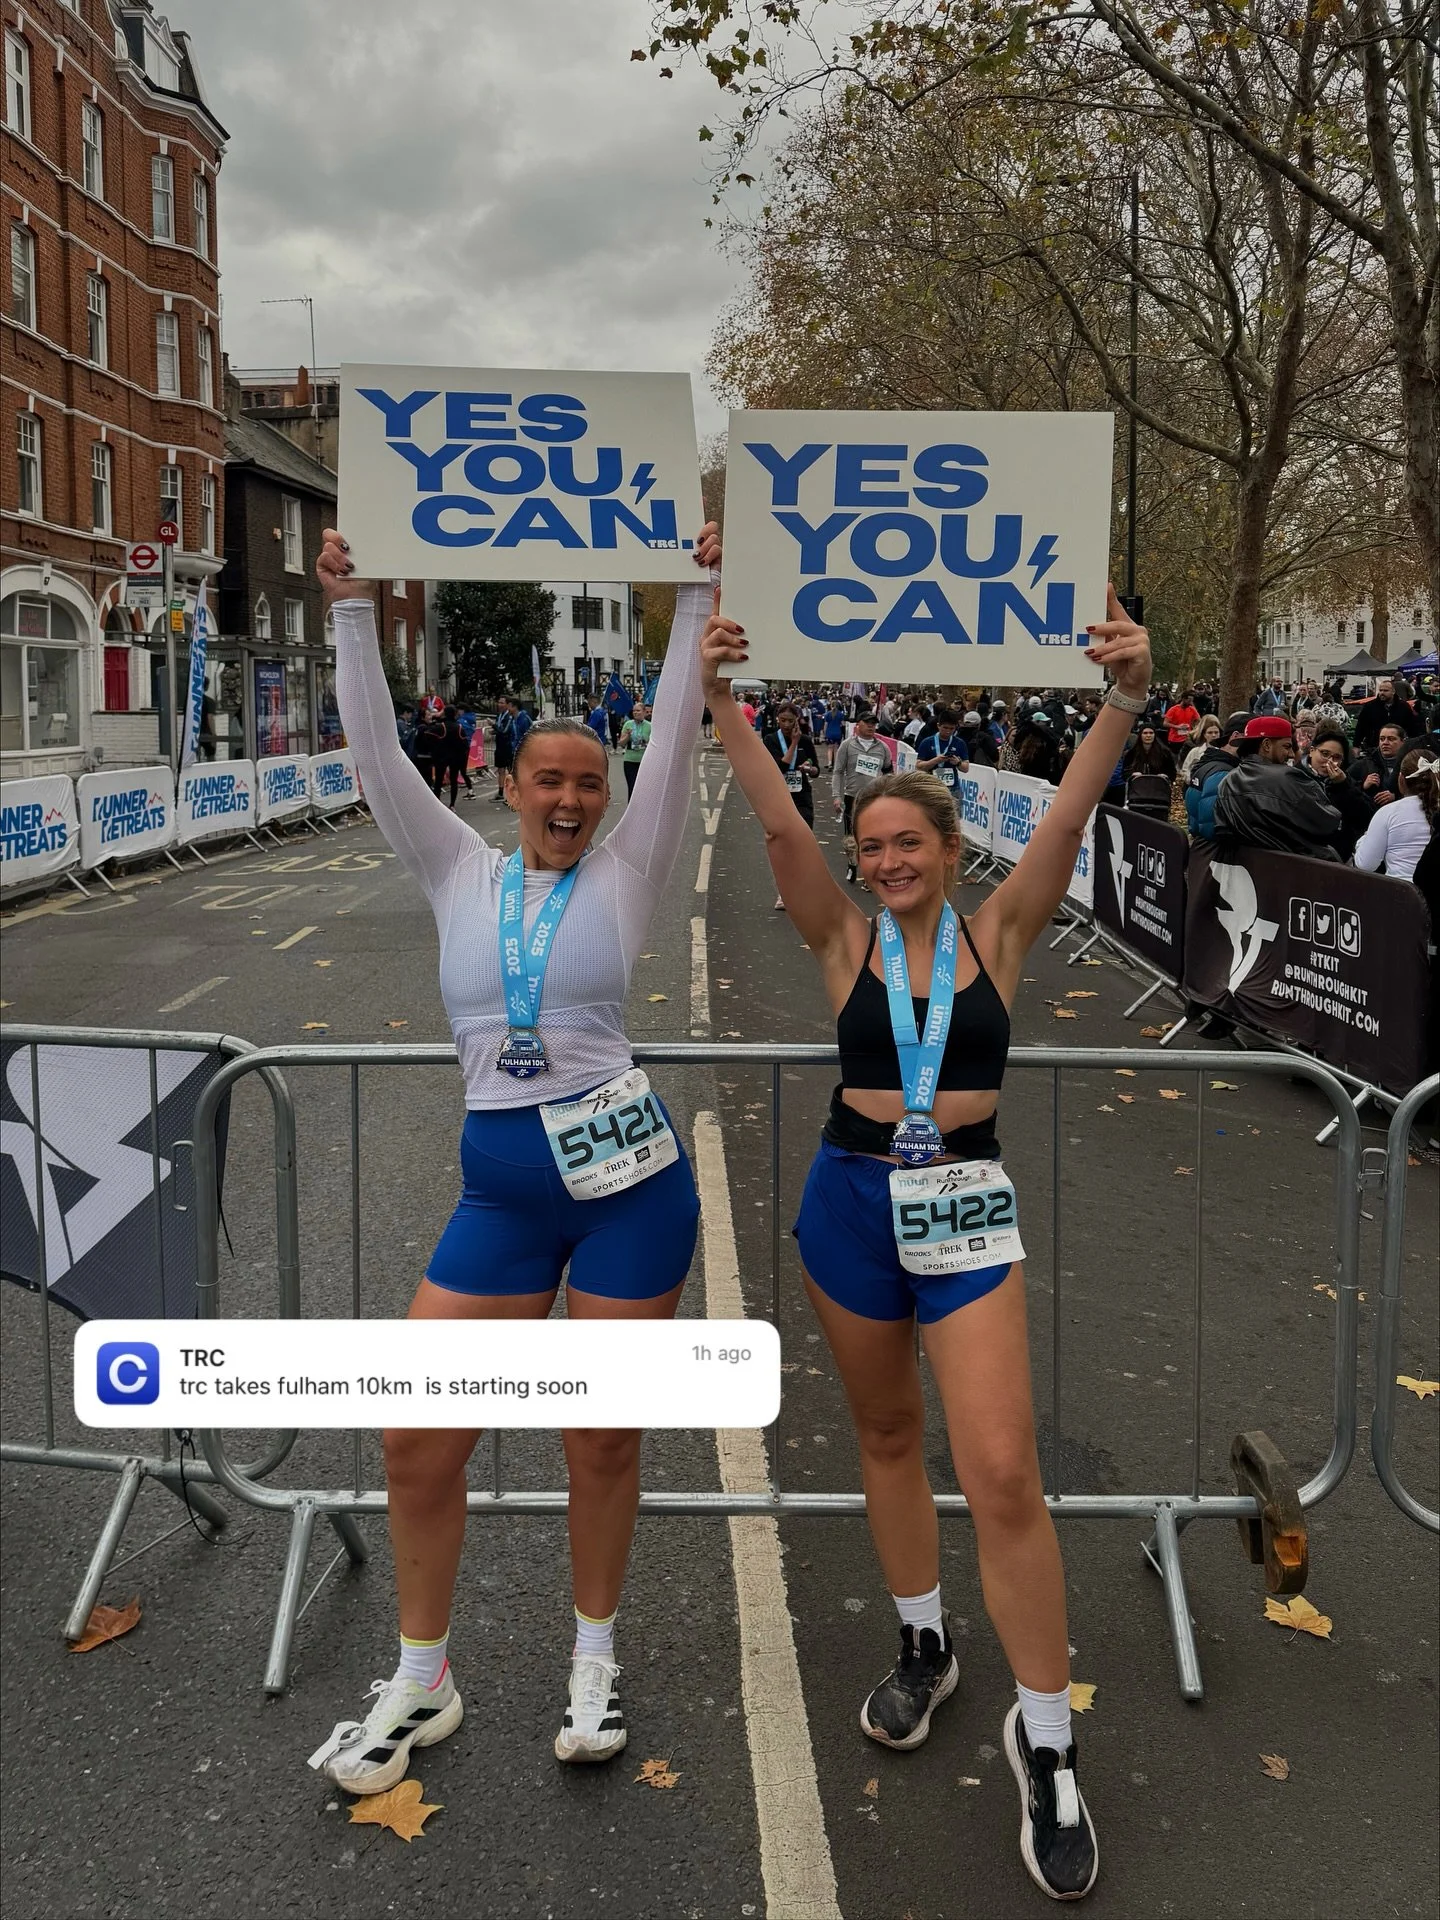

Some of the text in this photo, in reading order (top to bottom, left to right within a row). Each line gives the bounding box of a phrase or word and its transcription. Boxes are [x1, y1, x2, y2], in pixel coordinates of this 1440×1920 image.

[355, 389, 588, 443] YES
[743, 443, 989, 509] YES
[160, 526, 175, 536] GL
[411, 495, 694, 549] CAN.
[648, 539, 677, 549] TRC
[792, 578, 1090, 645] CAN.
[1039, 634, 1071, 645] TRC
[264, 765, 297, 790] RUNNER
[316, 763, 344, 784] RUNNER
[858, 759, 879, 770] 5427
[184, 775, 235, 802] RUNNER
[269, 779, 306, 806] RETREATS
[320, 777, 353, 797] RETREATS
[93, 789, 147, 822] RUNNER
[192, 793, 249, 820] RETREATS
[998, 790, 1032, 821] RUNNER
[101, 806, 165, 844] RETREATS
[216, 853, 397, 876] BUS
[531, 921, 551, 957] 2025
[883, 914, 897, 943] 2025
[942, 921, 955, 954] 2025
[505, 937, 520, 977] 2025
[1310, 950, 1340, 973] #RTKIT
[1284, 963, 1368, 1006] @RUNTHROUGHKIT
[1270, 979, 1380, 1037] RUNTHROUGHKIT.COM
[500, 1058, 546, 1067] FULHAM 10K
[915, 1066, 934, 1106] 2025
[558, 1097, 664, 1169] 5421
[895, 1142, 926, 1150] FULHAM
[572, 1173, 598, 1186] BROOKS
[604, 1158, 630, 1174] TREK
[592, 1158, 664, 1193] SPORTSSHOES.COM
[937, 1175, 972, 1184] RunThrough
[900, 1191, 1013, 1240] 5422
[939, 1244, 963, 1255] TREK
